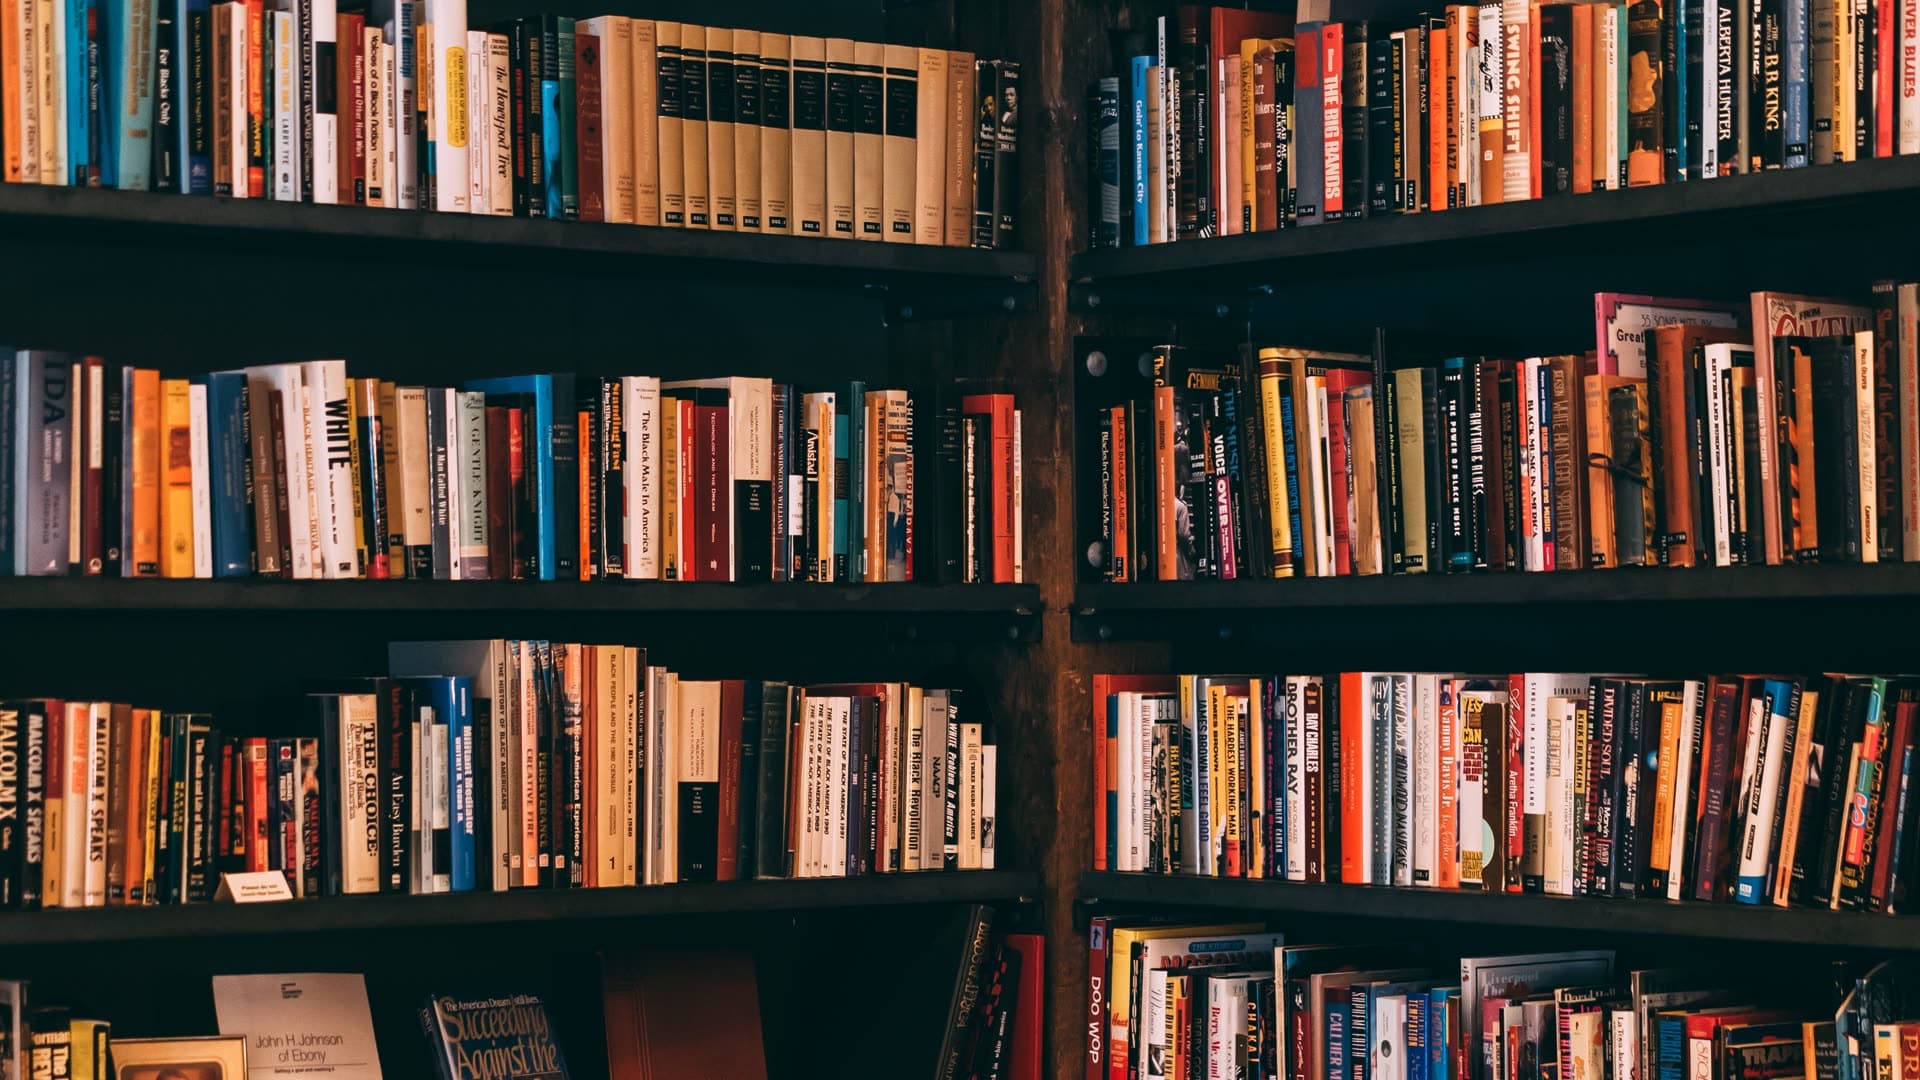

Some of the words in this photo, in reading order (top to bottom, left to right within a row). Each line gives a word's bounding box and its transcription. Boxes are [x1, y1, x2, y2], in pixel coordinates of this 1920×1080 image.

[370, 35, 378, 67] Voices
[1718, 7, 1731, 74] ALBERTA
[159, 49, 169, 66] For
[303, 65, 312, 78] IN
[1506, 25, 1520, 90] SWING
[1904, 45, 1915, 98] BLUES
[159, 68, 169, 98] Blacks
[370, 69, 380, 79] of
[496, 66, 506, 83] The
[1324, 74, 1338, 106] THE
[304, 80, 312, 102] THE
[354, 85, 363, 98] and
[370, 90, 380, 117] Black
[158, 103, 169, 125] Only
[354, 99, 363, 120] Other
[1325, 109, 1339, 136] BIG
[1507, 95, 1521, 153] SHIFT
[1718, 78, 1731, 141] HUNTER
[1765, 87, 1779, 132] KING
[355, 122, 363, 141] Hard
[1447, 126, 1457, 139] of
[355, 142, 363, 158] Work
[498, 153, 509, 178] Tree
[1136, 143, 1144, 180] Kansas
[1447, 142, 1457, 171] JAZZ
[1325, 138, 1340, 199] BANDS
[1136, 182, 1145, 203] City
[44, 359, 66, 426] IDA
[1449, 400, 1457, 416] THE
[471, 413, 480, 422] A
[610, 383, 621, 442] Standing
[642, 410, 651, 431] The
[776, 409, 784, 439] GEORGE
[325, 399, 352, 470] WHITE
[642, 433, 650, 462] Black
[1101, 431, 1109, 459] Blacks
[1450, 421, 1458, 454] POWER
[1469, 412, 1483, 454] RHYTHM
[437, 455, 446, 472] Man
[471, 428, 482, 482] GENTLE
[612, 444, 621, 471] Fast
[807, 430, 817, 475] Amistad
[1213, 435, 1225, 476] VOICE
[437, 473, 446, 498] Called
[642, 464, 650, 491] Male
[1451, 473, 1459, 503] BLACK
[1471, 464, 1484, 496] BLUES
[437, 501, 447, 525] White
[473, 489, 483, 544] KNIGHT
[1216, 479, 1228, 526] OVER
[642, 508, 650, 553] America
[1102, 511, 1110, 540] Music
[1453, 508, 1461, 537] MUSIC
[949, 705, 957, 719] The
[1227, 705, 1235, 721] THE
[1287, 683, 1297, 758] BROTHER
[1306, 713, 1319, 730] RAY
[1576, 714, 1585, 737] KIRK
[1601, 688, 1615, 743] DIVIDED
[365, 723, 376, 769] THE
[912, 727, 922, 747] The
[949, 722, 957, 748] WHITE
[1227, 724, 1235, 764] HARDEST
[1440, 708, 1454, 752] Sammy
[0, 710, 18, 803] MALCOLM
[27, 714, 42, 789] MALCOLM
[464, 725, 472, 775] Militant
[1306, 731, 1319, 773] CHARLES
[1576, 740, 1584, 788] FRANKLIN
[1600, 744, 1613, 780] SOUL
[1660, 746, 1670, 782] MERCY
[392, 772, 403, 790] An
[526, 748, 534, 806] CREATIVE
[912, 752, 921, 784] Black
[932, 757, 940, 798] NAACP
[948, 752, 957, 785] Problem
[1170, 745, 1180, 817] BELAFONTE
[1288, 764, 1298, 795] RAY
[1442, 756, 1454, 790] Davis
[27, 791, 42, 802] X
[1509, 770, 1518, 800] Aretha
[1659, 784, 1667, 799] ME
[0, 806, 17, 820] X
[388, 793, 404, 820] Easy
[464, 777, 473, 835] Mediator
[908, 789, 921, 850] Revolution
[946, 801, 955, 837] America
[1509, 801, 1518, 837] Franklin
[27, 807, 42, 863] SPEAKS
[90, 809, 104, 862] SPEAKS
[527, 811, 535, 839] FIRE
[1228, 815, 1236, 835] MAN
[392, 823, 403, 867] Burden
[1091, 976, 1101, 1016] DOO
[255, 1034, 283, 1048] John
[299, 1034, 343, 1048] Johnson
[278, 1051, 289, 1062] of
[292, 1049, 326, 1064] Ebony
[1089, 1022, 1101, 1064] WOP
[456, 1039, 527, 1080] Against
[528, 1036, 560, 1072] the
[1211, 1059, 1219, 1078] and
